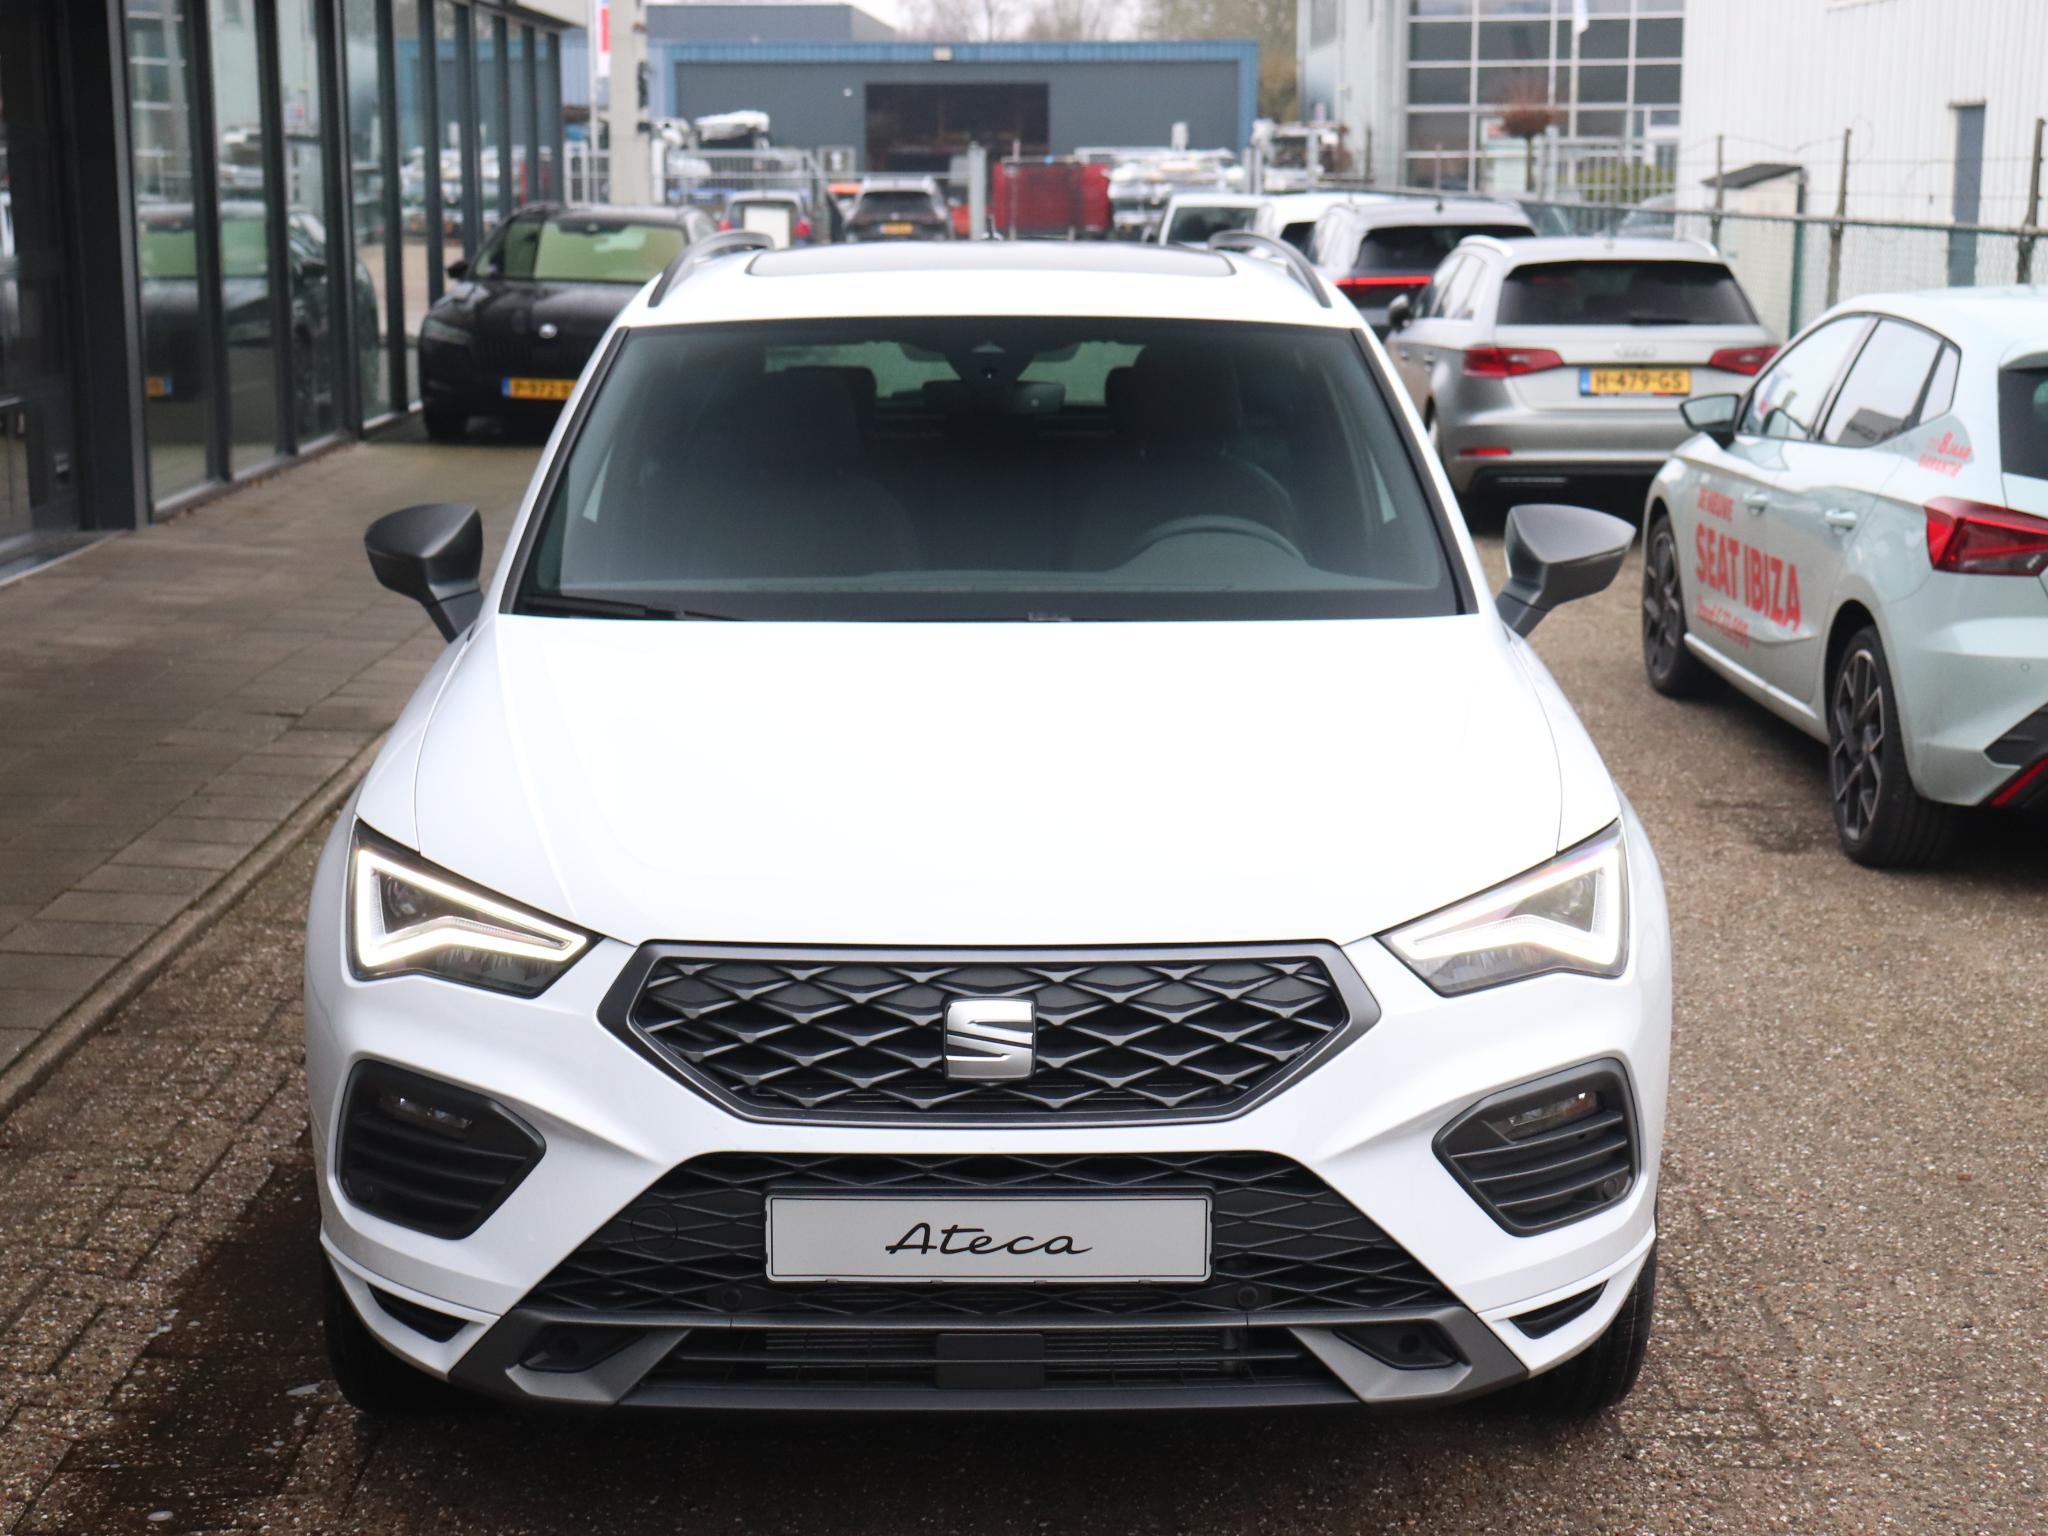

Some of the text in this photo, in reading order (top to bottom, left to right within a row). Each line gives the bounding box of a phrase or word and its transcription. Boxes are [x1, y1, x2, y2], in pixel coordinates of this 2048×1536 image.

[1594, 371, 1684, 391] H-479-GS
[1696, 522, 1739, 600] SEAT
[1744, 543, 1802, 633] IBIZA
[885, 1222, 1093, 1255] Ateca
